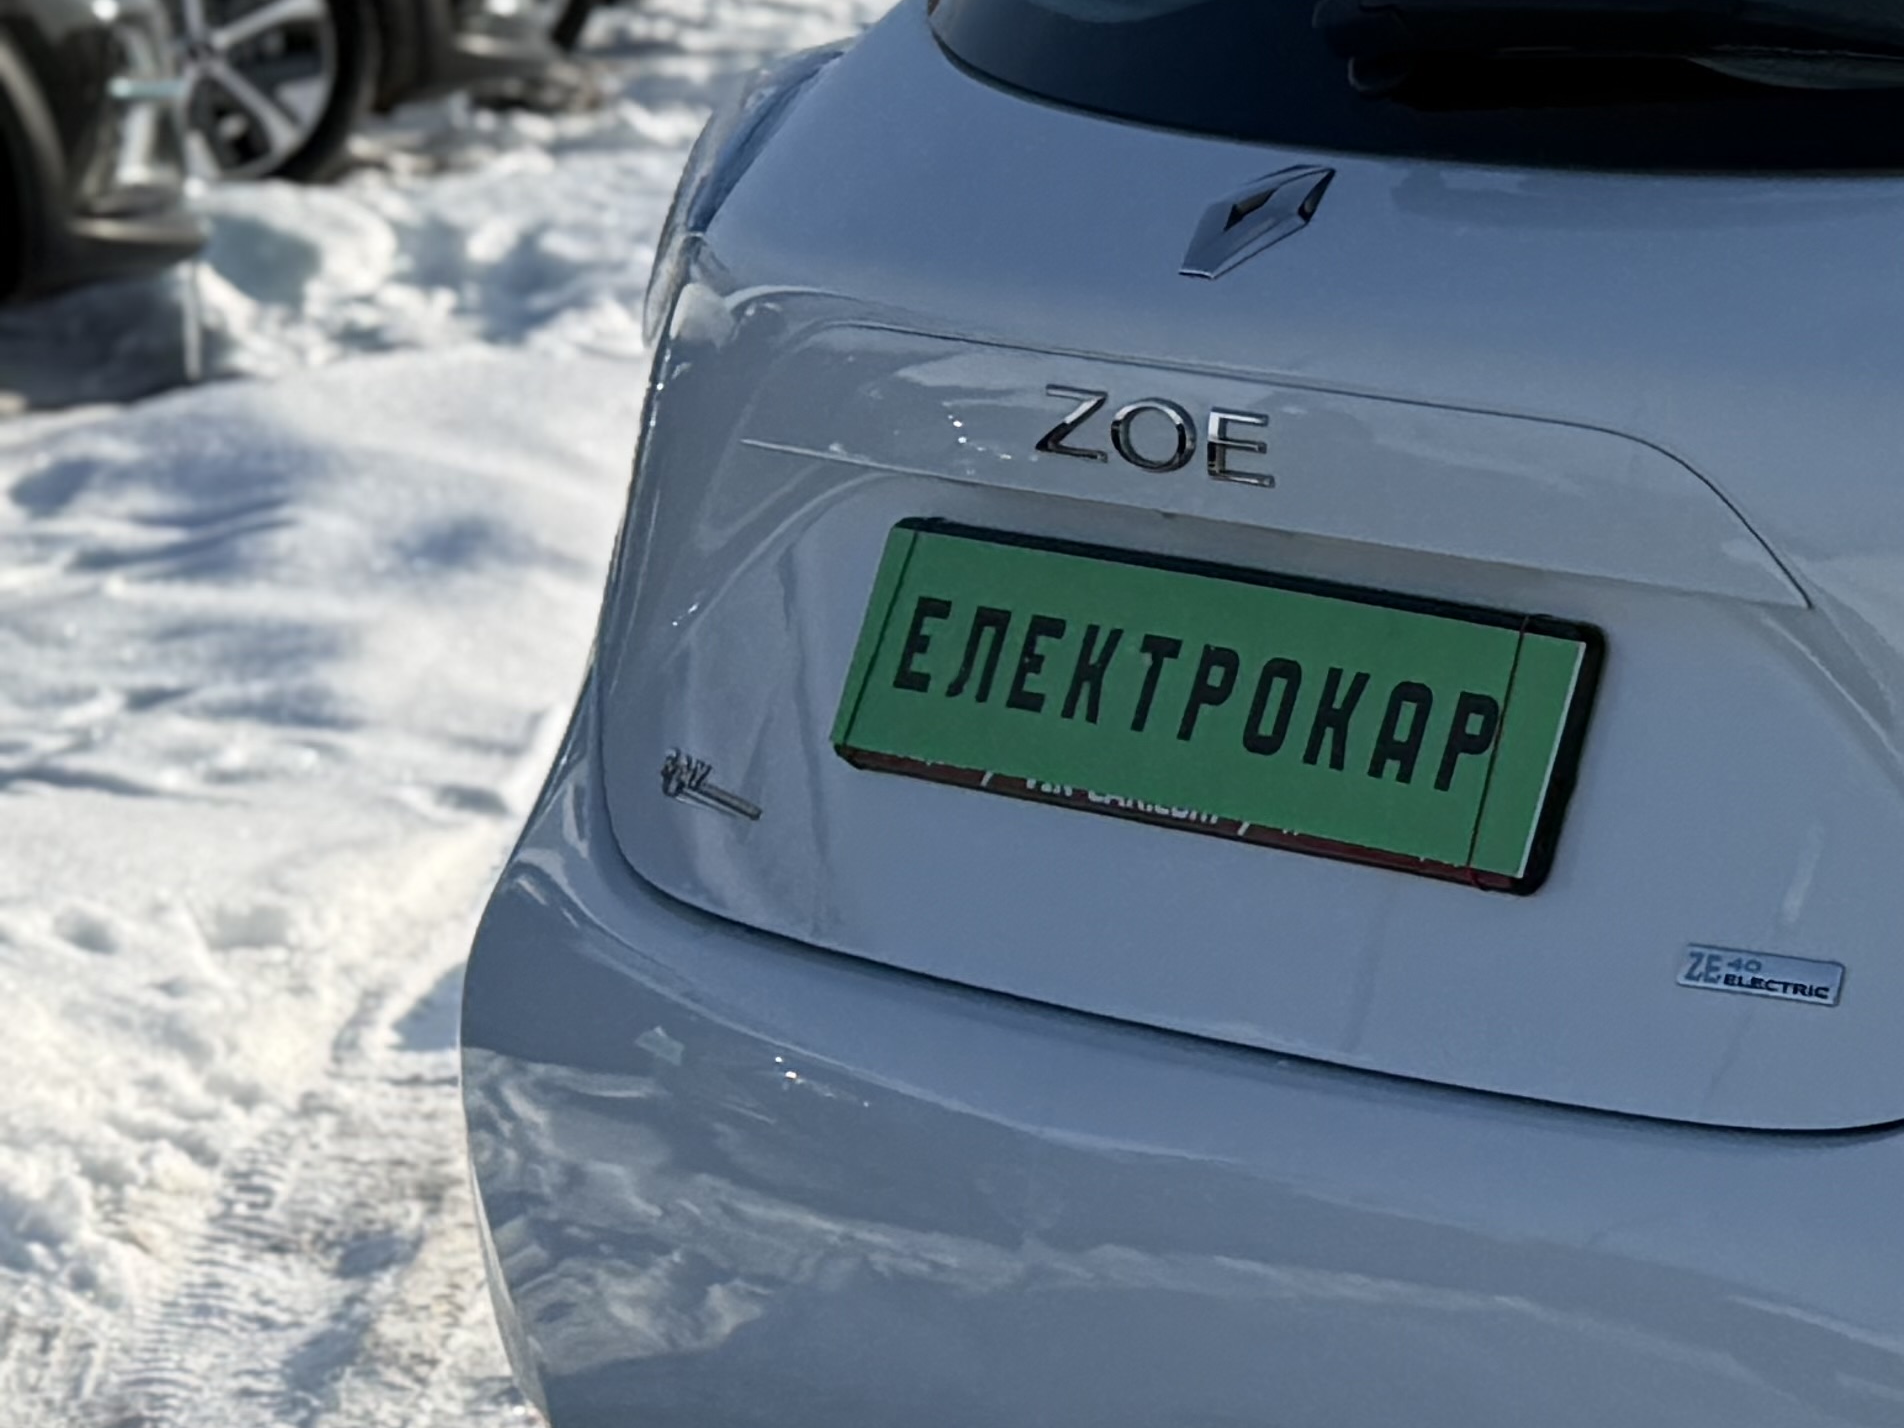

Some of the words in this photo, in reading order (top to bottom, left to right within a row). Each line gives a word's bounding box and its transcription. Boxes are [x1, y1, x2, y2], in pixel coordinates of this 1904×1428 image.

[1036, 383, 1275, 489] ZOE
[893, 596, 1501, 791] ЕЛЕКТРОКАР
[1723, 973, 1831, 1000] ELECTRIC
[1727, 957, 1763, 973] 40
